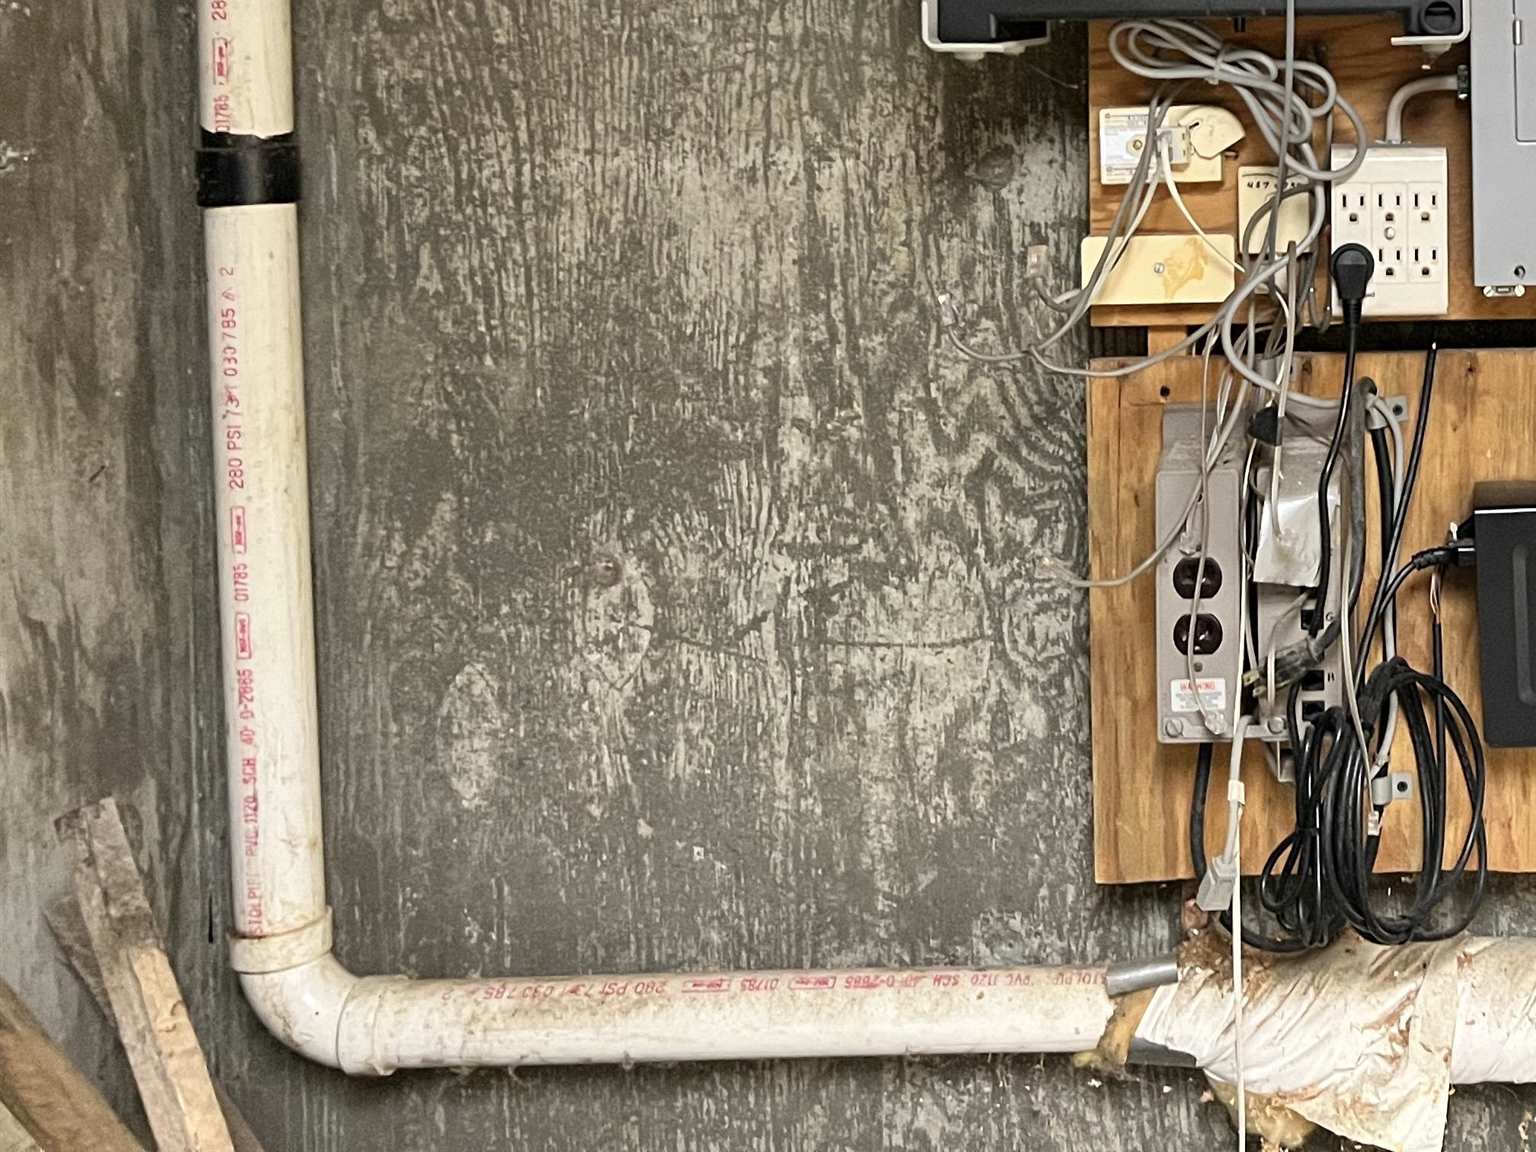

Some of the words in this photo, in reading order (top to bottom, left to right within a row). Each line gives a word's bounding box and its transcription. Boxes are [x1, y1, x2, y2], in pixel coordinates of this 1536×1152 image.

[226, 426, 242, 450] PSI
[228, 458, 244, 489] 280
[634, 980, 668, 995] 280
